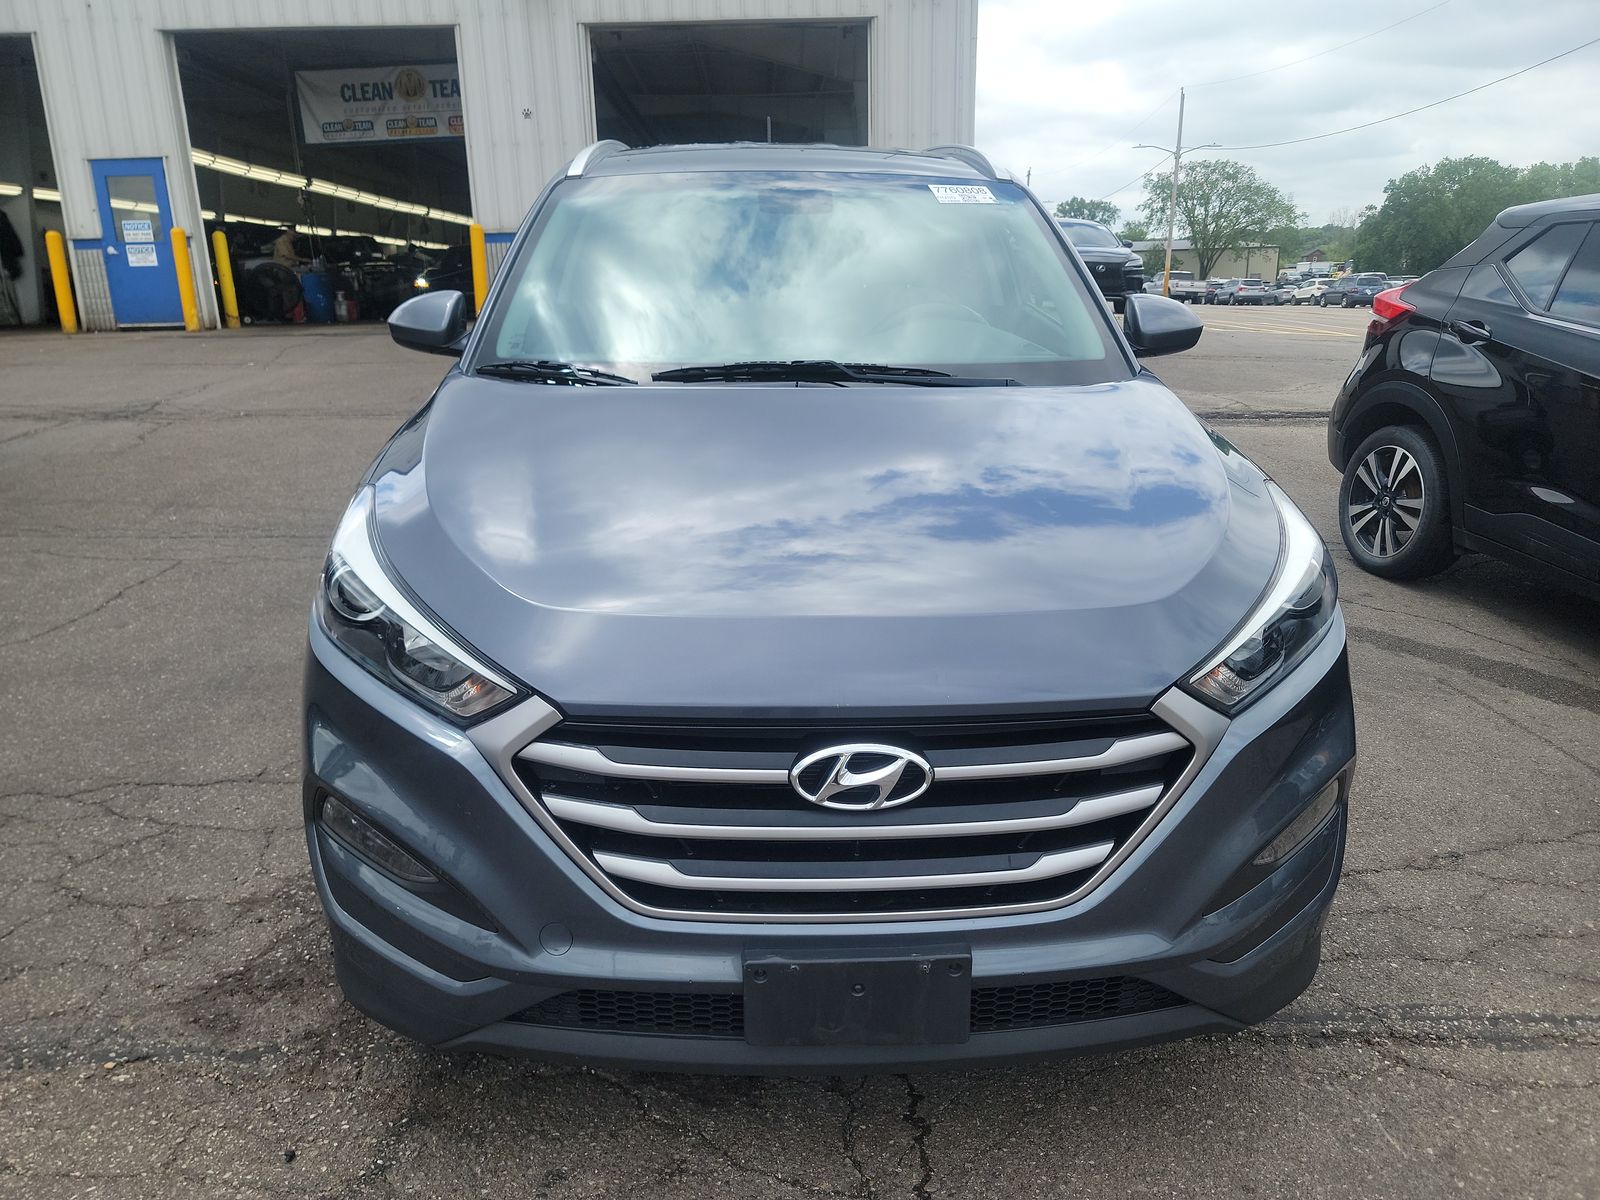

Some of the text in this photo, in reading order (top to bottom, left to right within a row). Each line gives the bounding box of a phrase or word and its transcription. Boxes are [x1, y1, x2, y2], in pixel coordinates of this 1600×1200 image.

[340, 82, 393, 102] CLEAN
[323, 121, 373, 132] CLEAN TEAM
[387, 117, 436, 129] CLEAN TEAM
[124, 223, 149, 231] NOTICE
